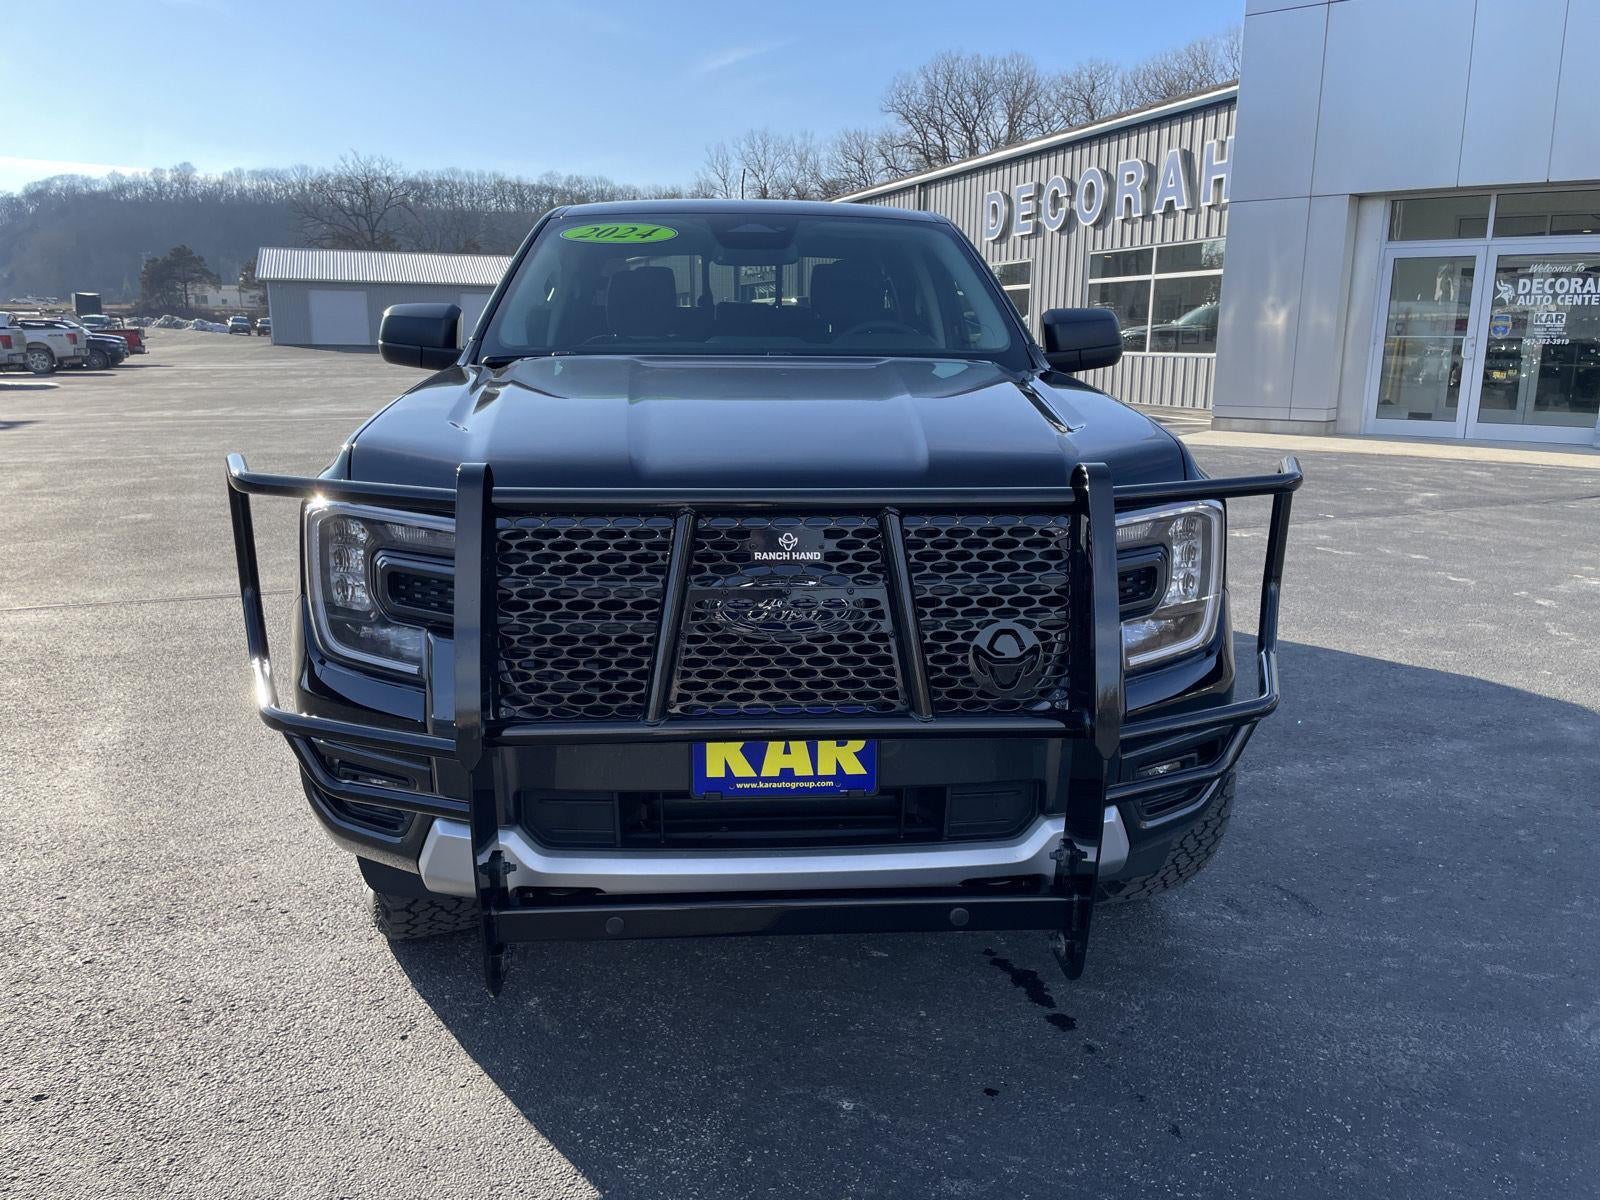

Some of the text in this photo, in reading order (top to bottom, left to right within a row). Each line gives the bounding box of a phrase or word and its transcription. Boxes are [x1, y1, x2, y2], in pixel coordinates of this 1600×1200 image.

[984, 135, 1235, 242] DECORAH
[574, 226, 662, 239] 2024
[1528, 262, 1586, 273] Welcome To
[1516, 294, 1553, 306] AUTO
[1534, 313, 1566, 324] KAR
[754, 551, 821, 560] RANCH HAND
[706, 740, 868, 777] KAR
[736, 780, 834, 789] www.karautogroup.com
